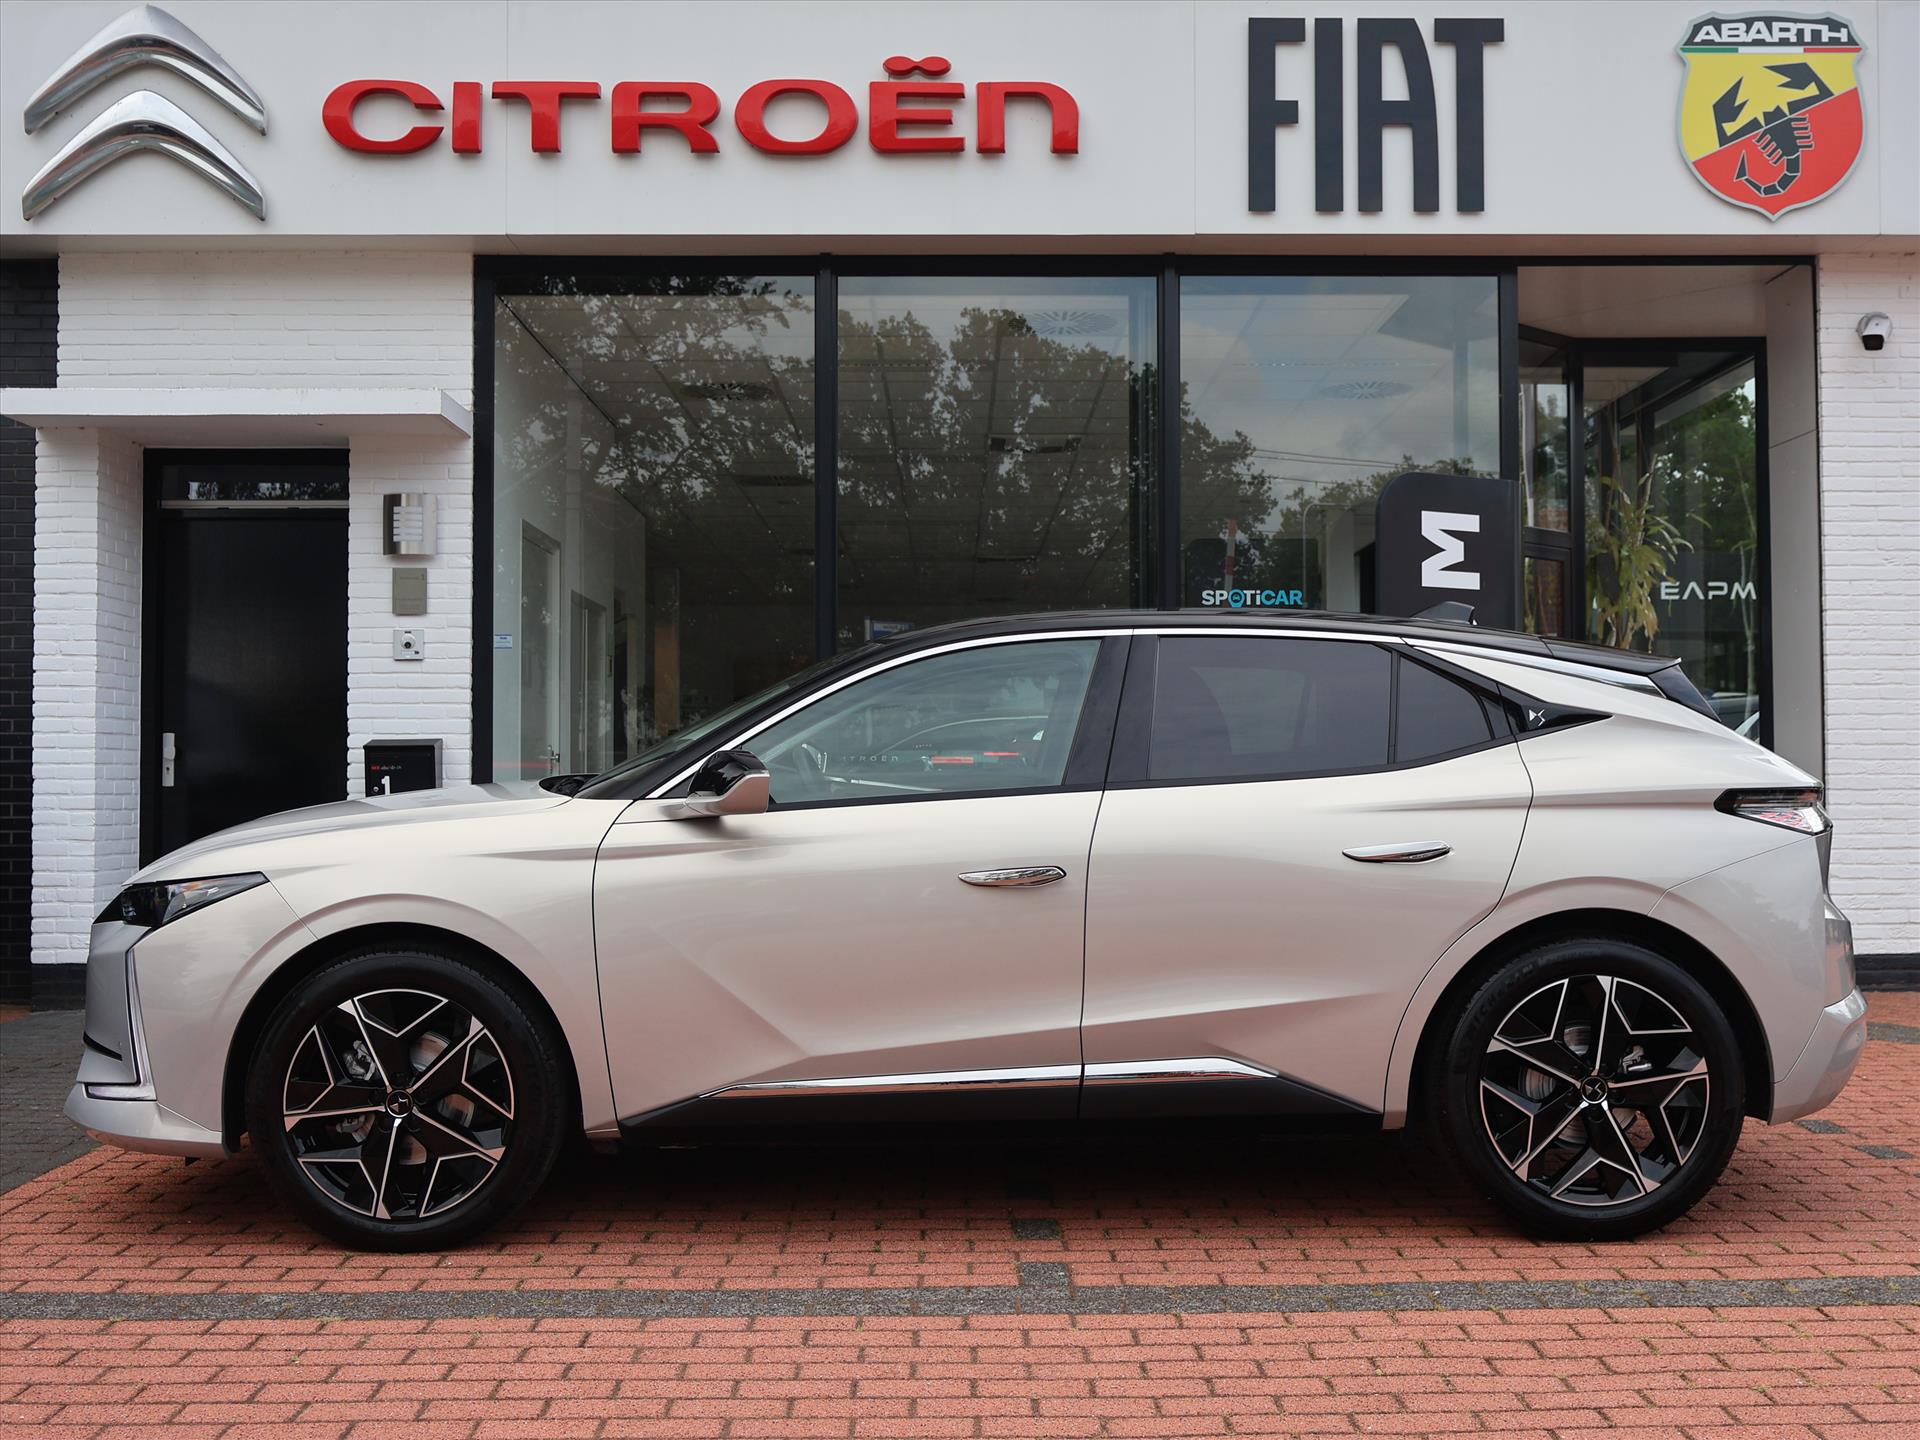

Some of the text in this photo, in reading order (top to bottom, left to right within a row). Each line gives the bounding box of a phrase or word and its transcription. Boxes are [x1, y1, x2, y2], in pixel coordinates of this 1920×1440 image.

[1693, 21, 1848, 43] ABARTH
[322, 56, 1081, 155] CITROËN
[1248, 18, 1504, 212] FIAT
[381, 775, 391, 795] 1
